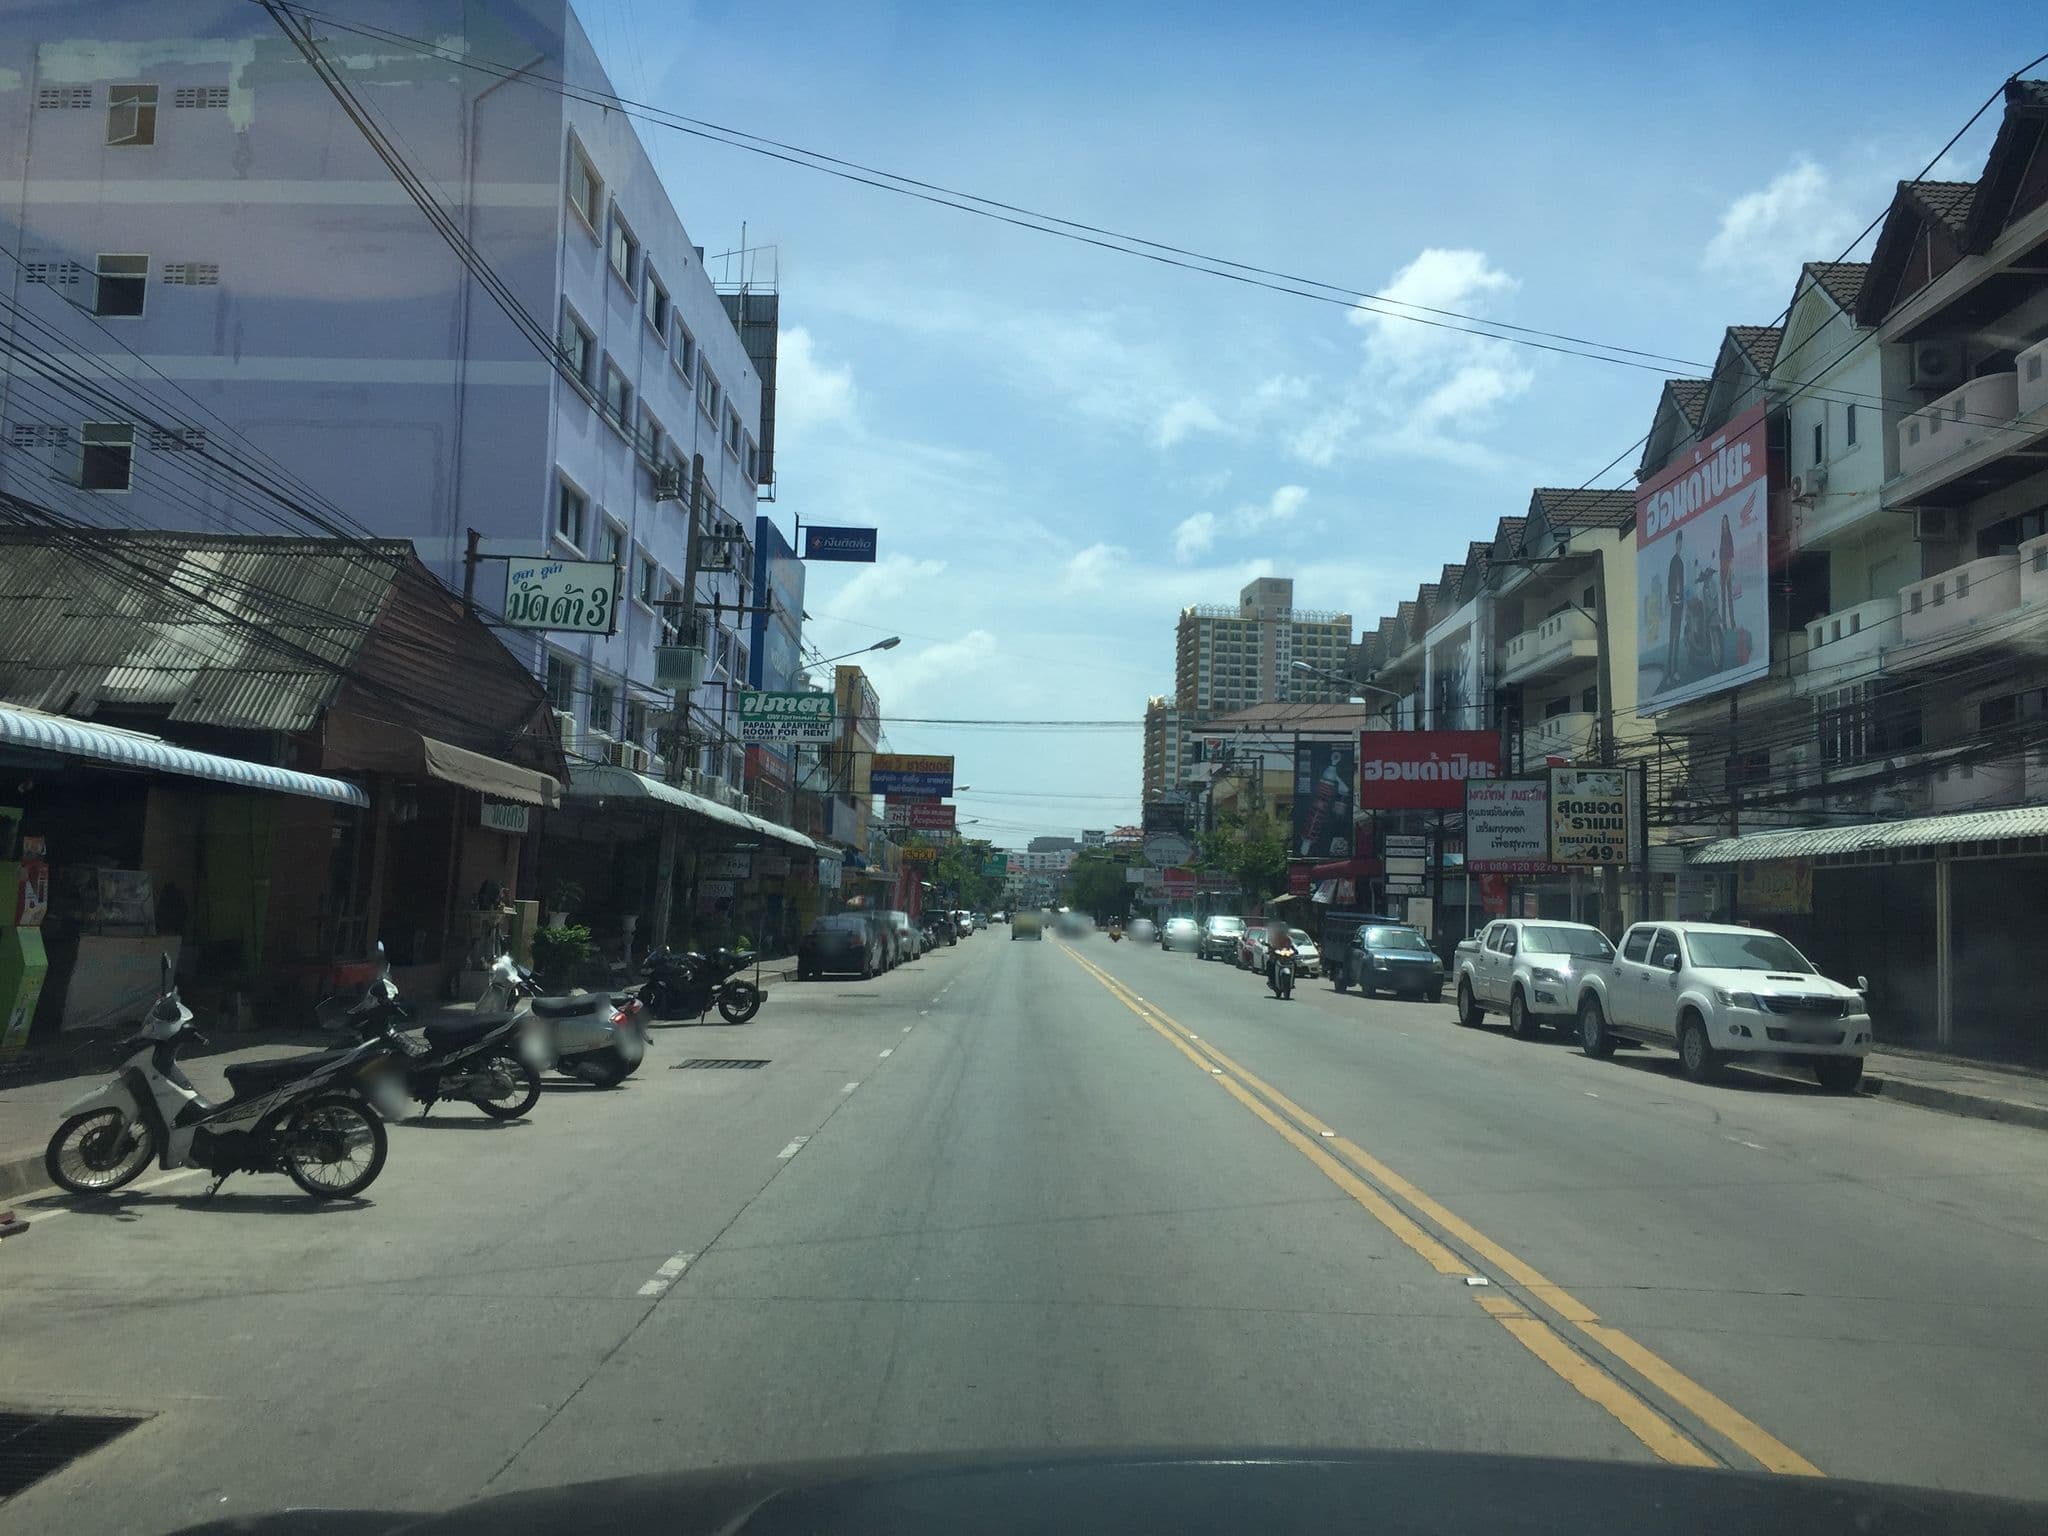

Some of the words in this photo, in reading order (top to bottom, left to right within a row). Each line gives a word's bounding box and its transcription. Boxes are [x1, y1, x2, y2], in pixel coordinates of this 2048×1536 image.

[743, 721, 776, 729] PAPADA
[781, 721, 831, 730] APARTMENT
[803, 729, 831, 737] RENT
[1364, 752, 1497, 781] ฮอนด้าปิยะ
[1557, 800, 1624, 819] สุดยอด
[1571, 816, 1624, 830] ราเมน
[1491, 834, 1540, 852] เพื่อสุขภาพ
[1586, 845, 1614, 860] 49
[1512, 861, 1530, 872] 120
